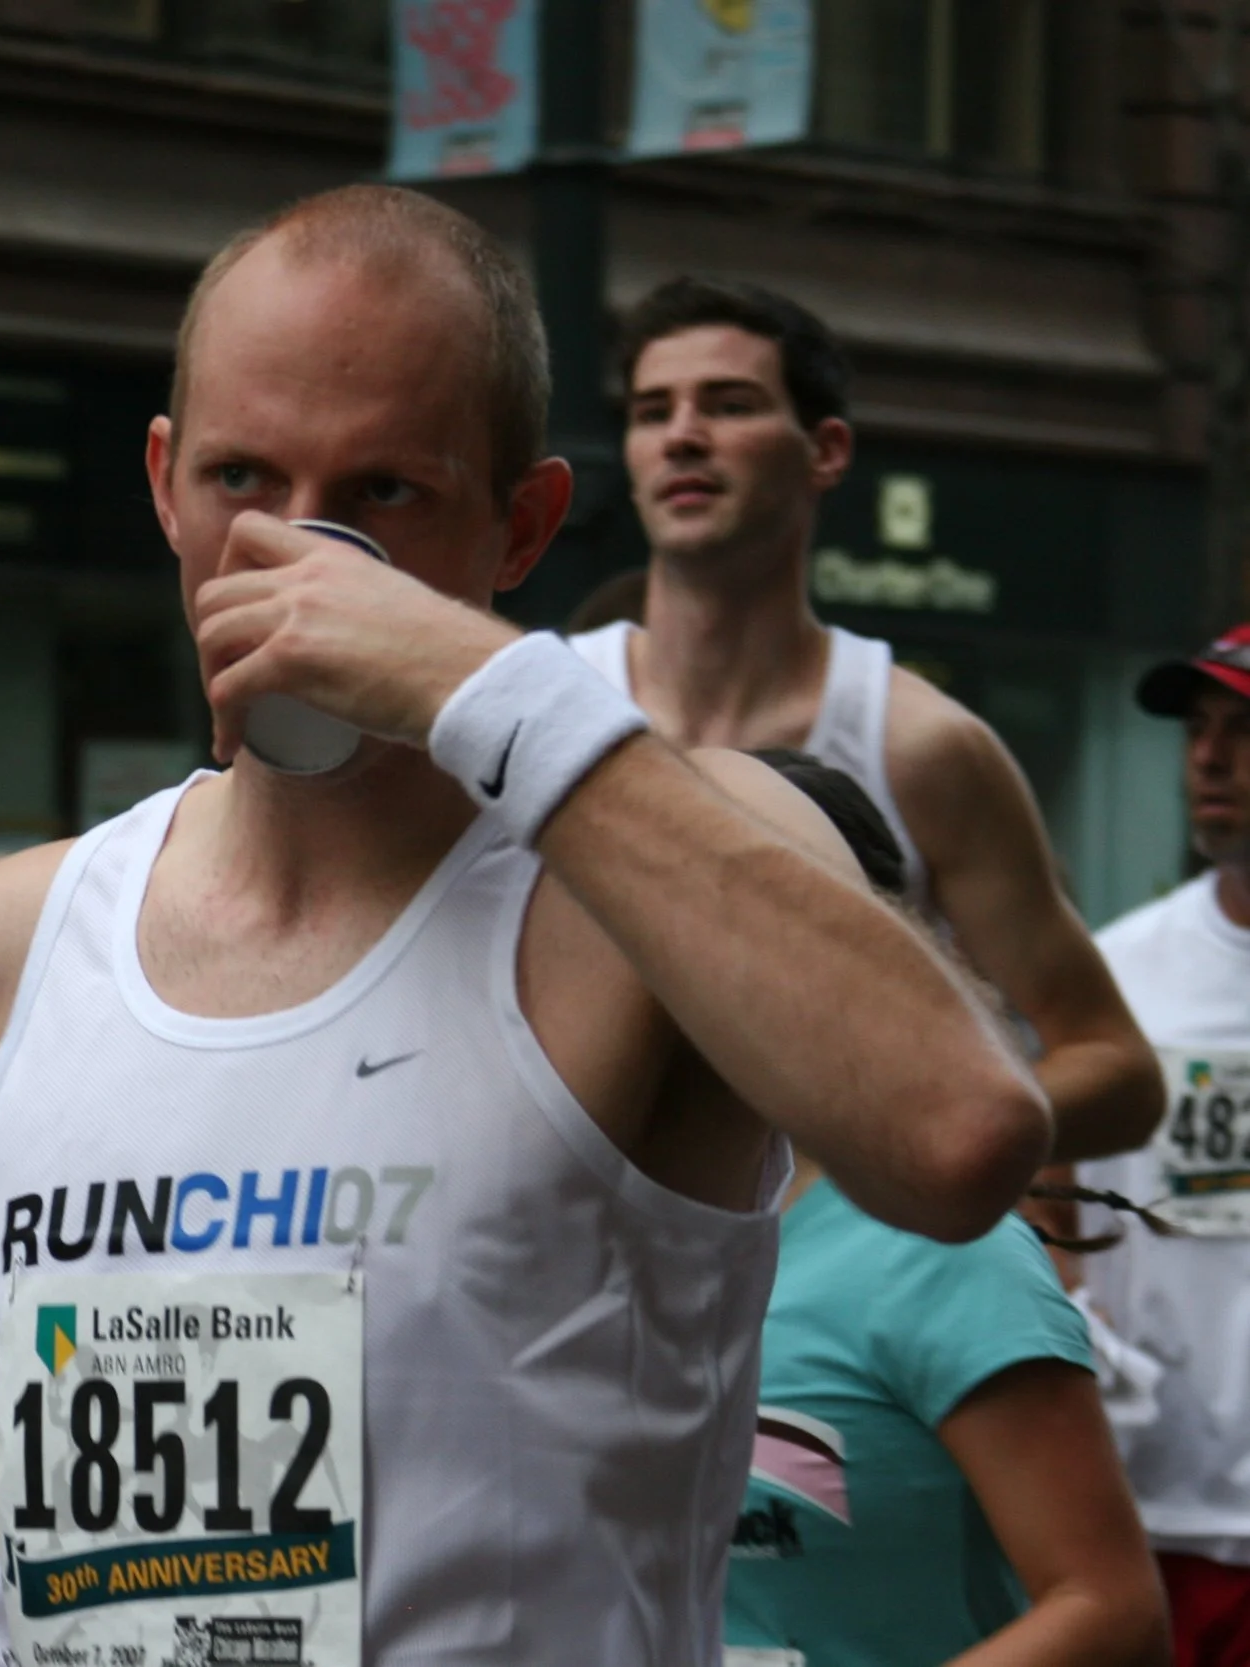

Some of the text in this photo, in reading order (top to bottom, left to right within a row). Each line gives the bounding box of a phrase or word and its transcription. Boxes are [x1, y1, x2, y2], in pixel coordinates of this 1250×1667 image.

[2, 1164, 436, 1275] RUNCHI07
[92, 1304, 295, 1341] LaSalle Bank
[91, 1353, 186, 1377] ABN AMRO
[13, 1377, 333, 1536] 18512
[46, 1540, 331, 1606] 30th ANNIVERSARY
